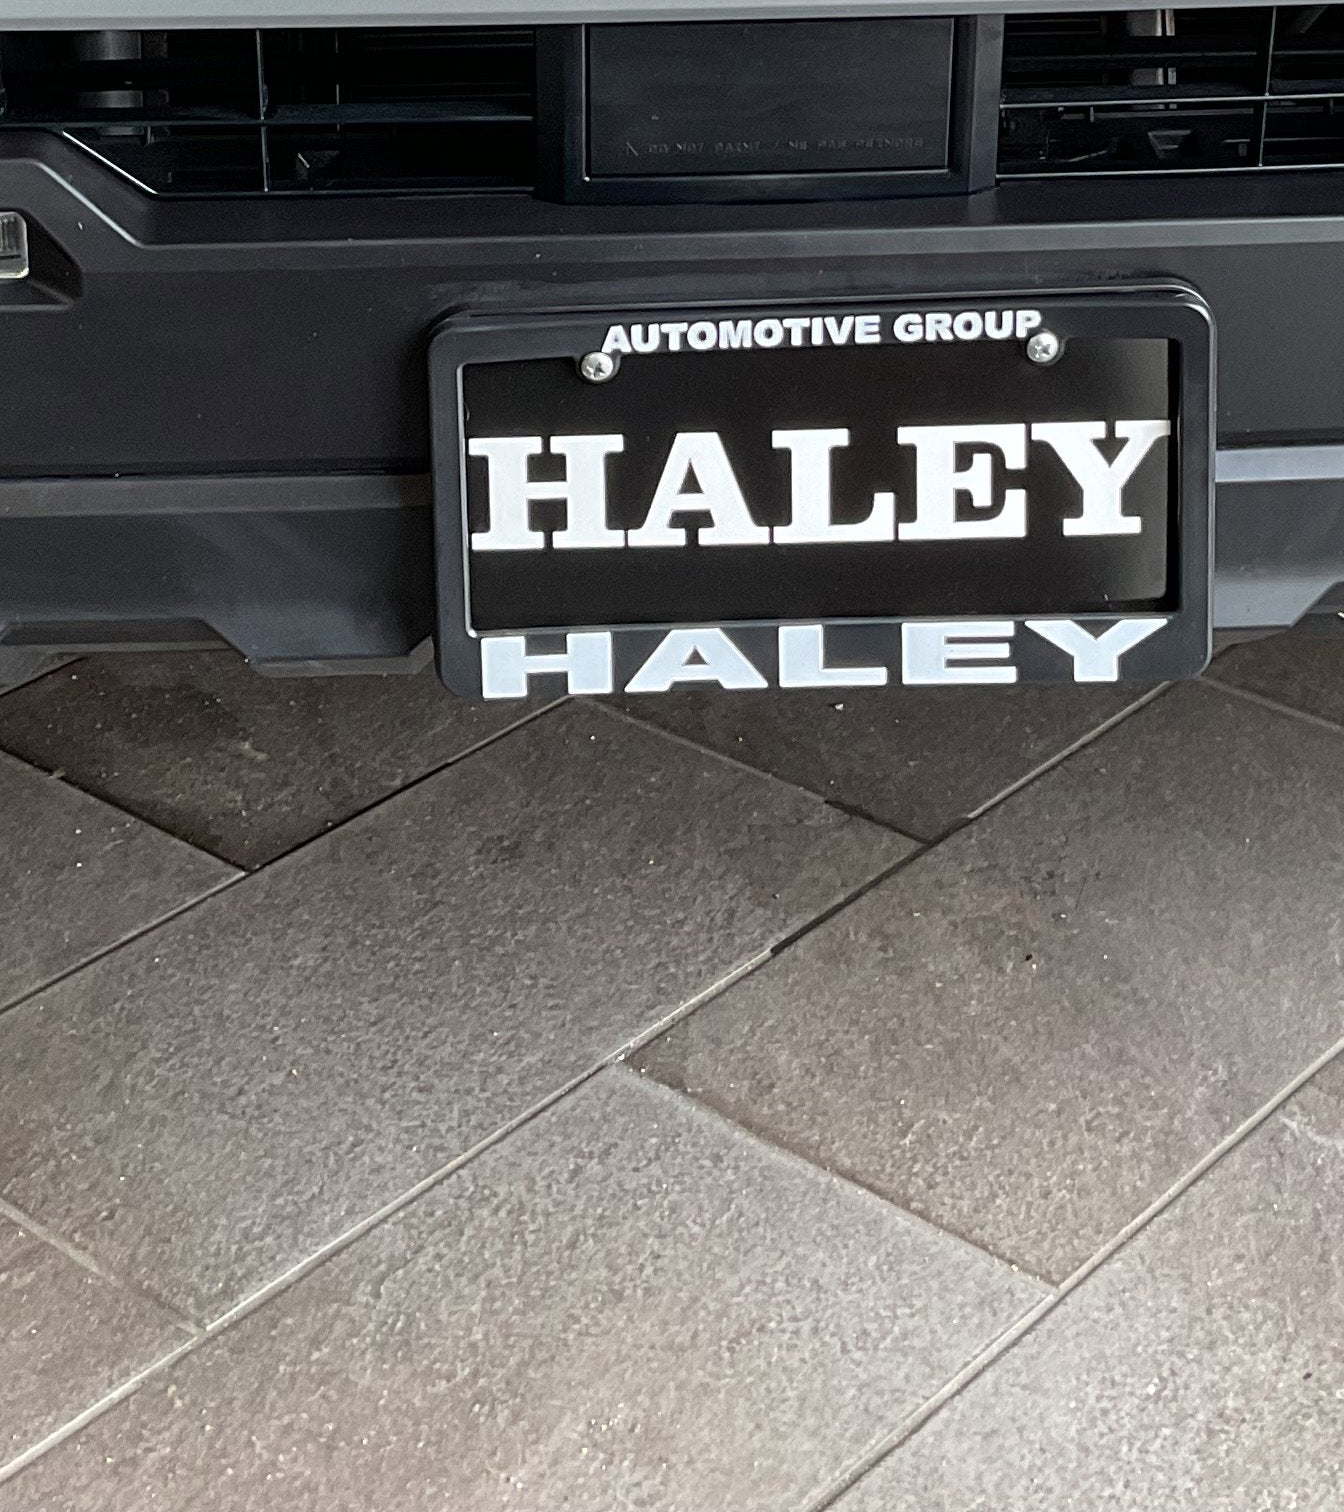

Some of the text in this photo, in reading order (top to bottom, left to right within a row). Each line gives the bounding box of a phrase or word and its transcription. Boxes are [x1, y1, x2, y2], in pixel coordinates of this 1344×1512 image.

[601, 309, 1042, 355] AUTOMOTIVE GROUP
[468, 420, 1171, 551] HALEY
[480, 618, 1168, 700] HALEY
